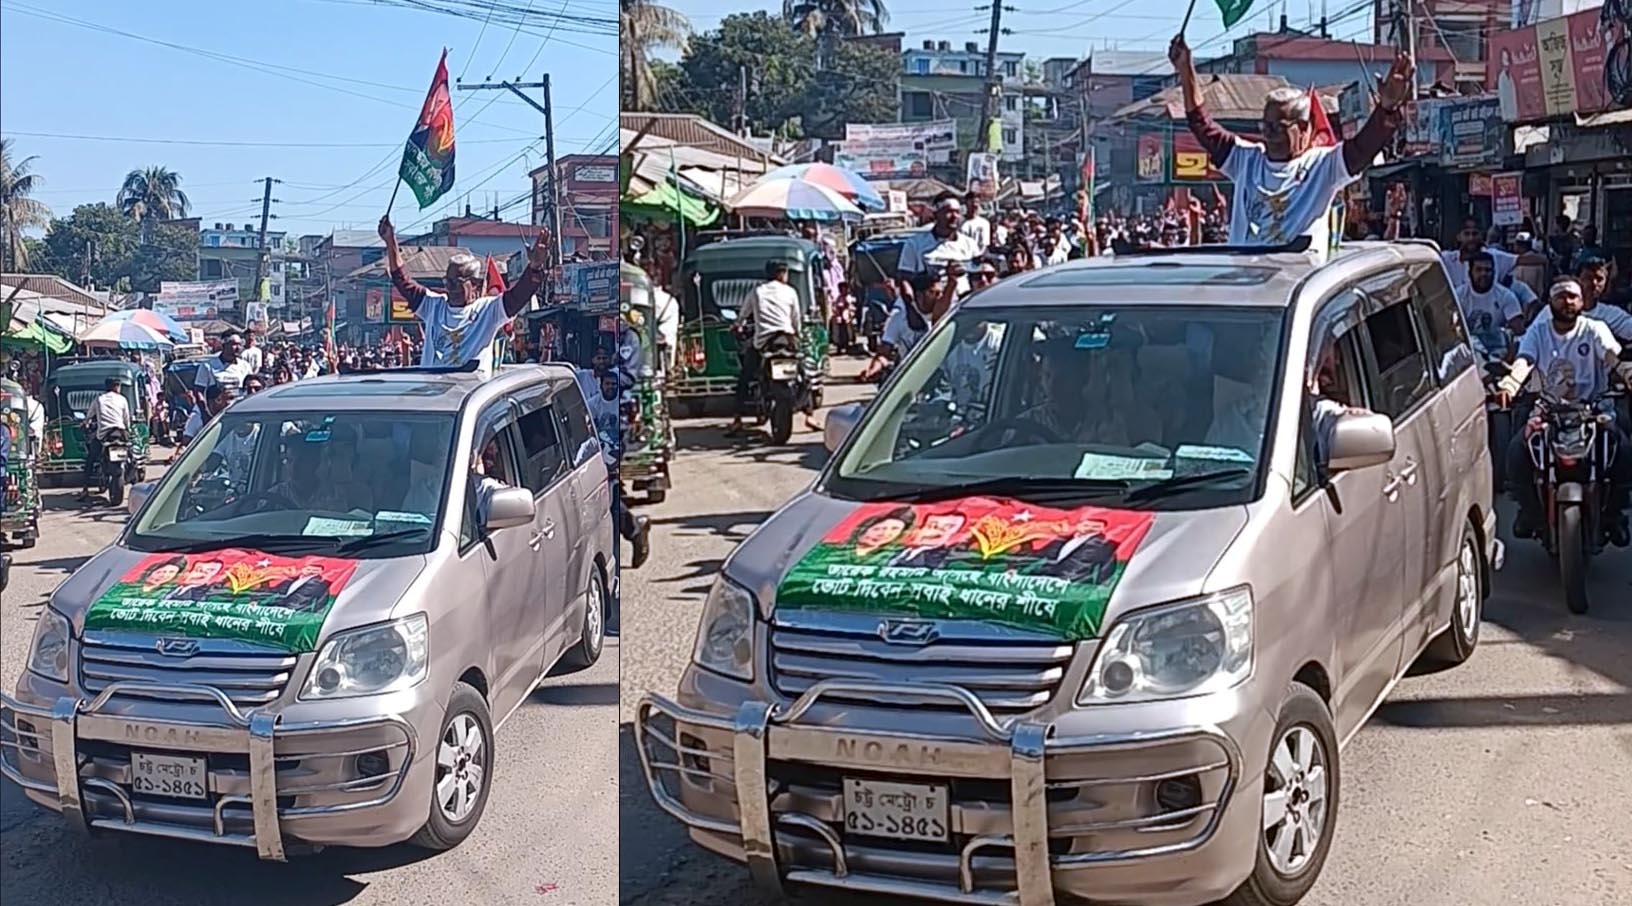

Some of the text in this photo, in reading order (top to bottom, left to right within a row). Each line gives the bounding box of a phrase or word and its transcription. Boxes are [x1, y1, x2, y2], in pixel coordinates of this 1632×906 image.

[812, 577, 854, 596] ভোট
[854, 579, 906, 599] দিবেন
[959, 588, 1012, 611] ধানের
[1016, 590, 1058, 618] শীষে
[110, 608, 139, 620] ভোট
[215, 616, 253, 631] ধানের
[255, 616, 287, 637] শীষে
[125, 724, 200, 744] NOAH
[836, 738, 940, 764] NOAH
[157, 763, 184, 778] মেট্রো
[134, 776, 204, 796] ৫১-১৪৫১
[854, 788, 937, 813] চট্ট মেট্রো চ
[847, 811, 945, 837] ৫১-১৪৫১
